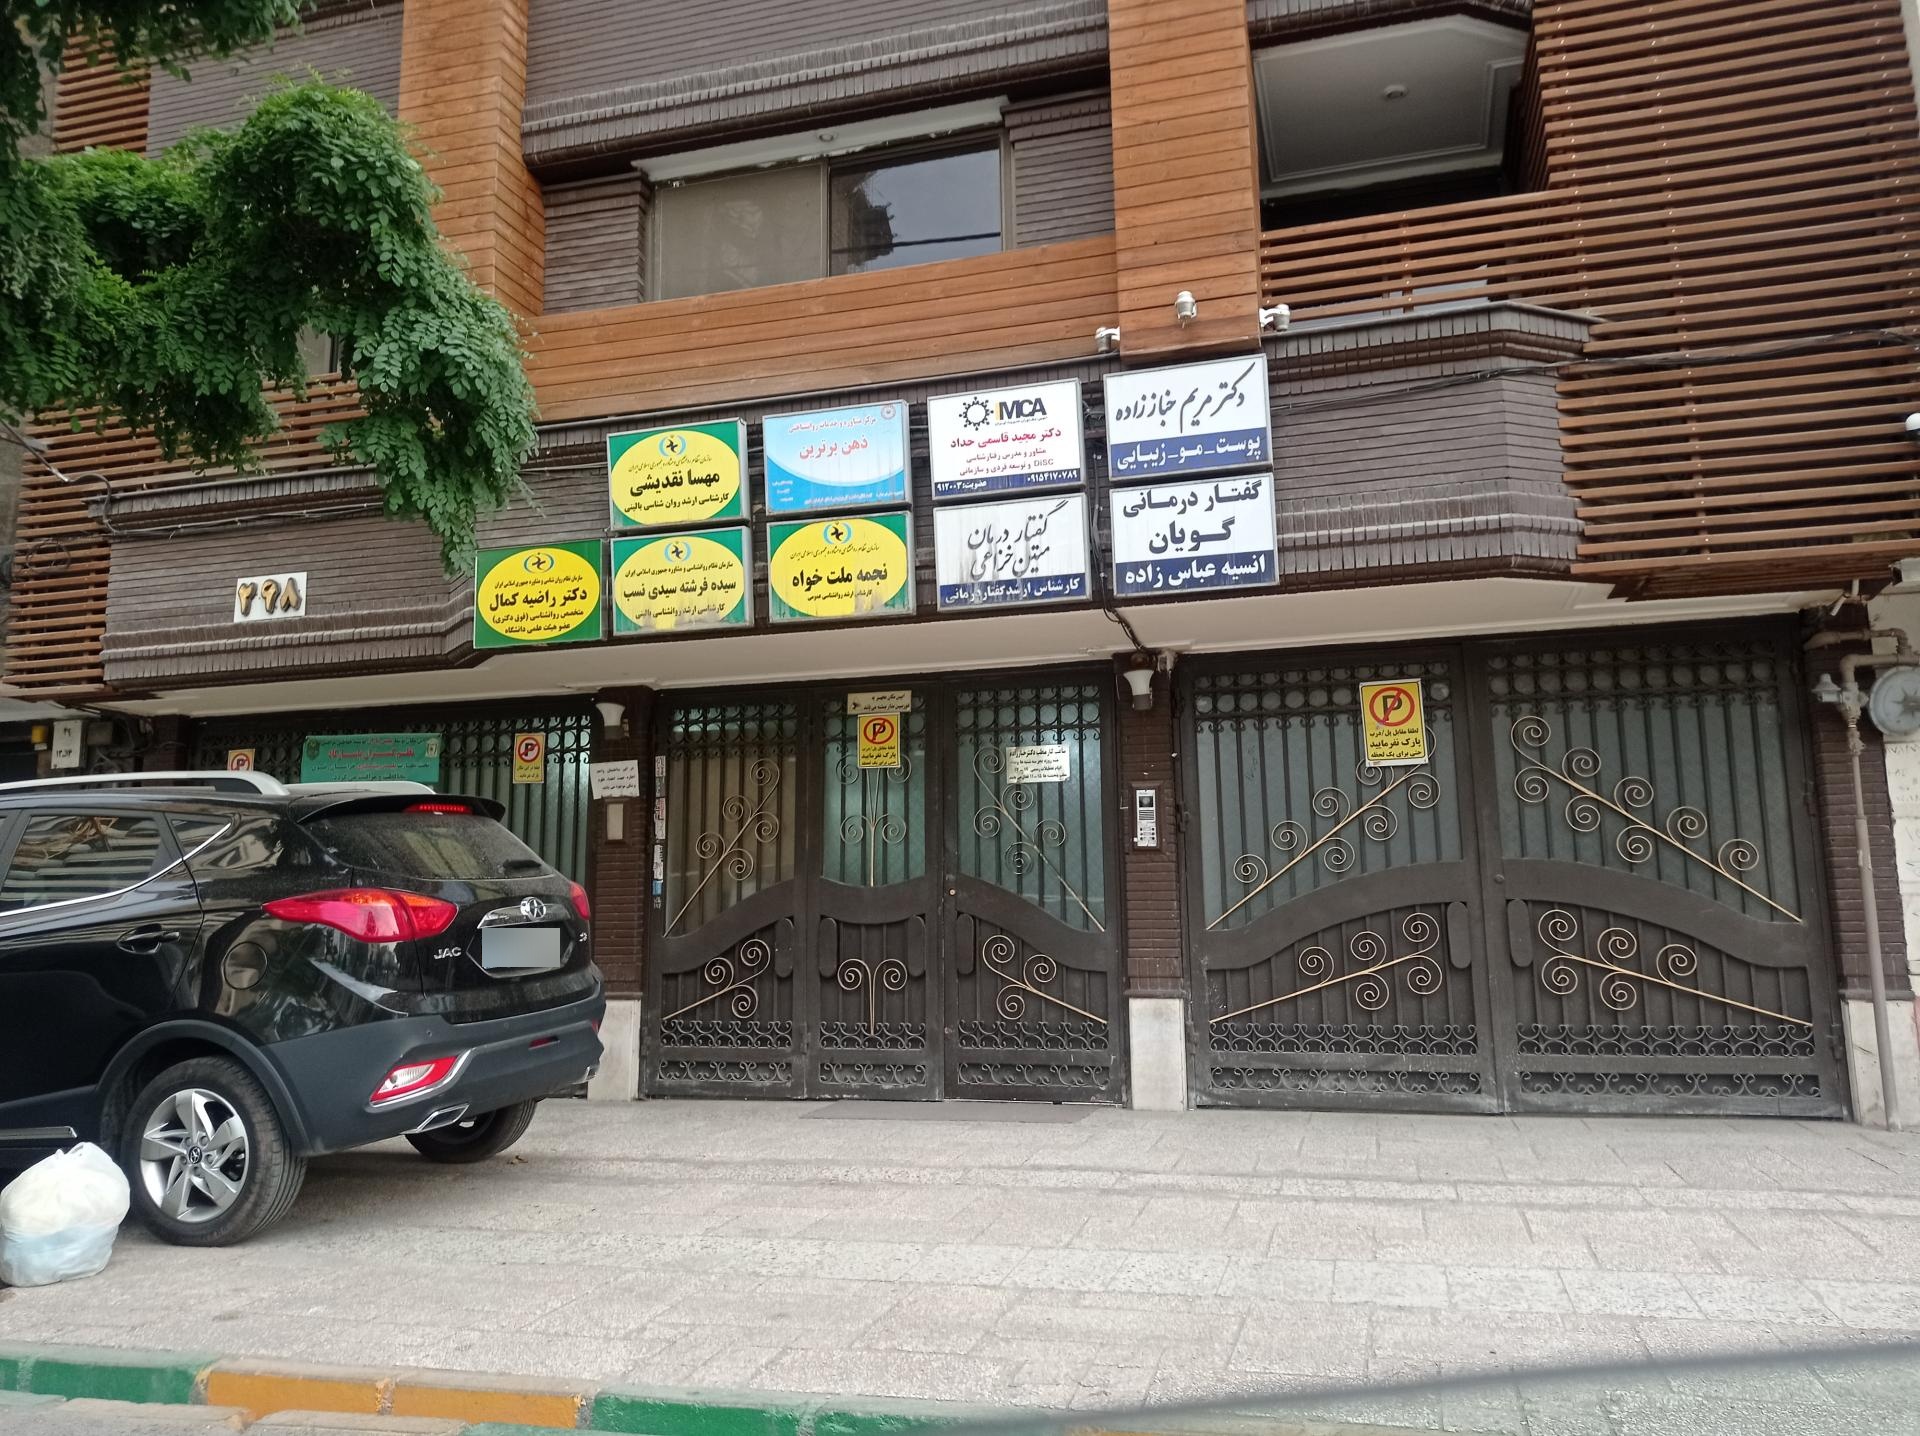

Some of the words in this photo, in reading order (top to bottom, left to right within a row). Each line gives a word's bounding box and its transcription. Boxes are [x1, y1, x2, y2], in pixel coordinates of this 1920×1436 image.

[1210, 362, 1256, 416] دکتر
[1180, 387, 1213, 434] مریم
[978, 432, 1009, 448] قاسمی
[1012, 432, 1036, 444] مجید
[1040, 427, 1061, 441] دکتر
[799, 439, 838, 460] برترین
[842, 434, 868, 456] ذهن
[950, 437, 975, 448] حداد
[1002, 452, 1021, 460] مدرس
[1029, 448, 1046, 457] مشاور
[959, 467, 984, 477] سازمانی
[991, 464, 1007, 473] فردی
[687, 468, 720, 488] مهسا
[665, 497, 680, 508] روان
[682, 495, 698, 506] ارشد
[699, 493, 730, 505] کارشناسی
[1123, 489, 1199, 518] درمانی
[1204, 479, 1262, 512] گفتار
[624, 502, 642, 513] بالینی
[643, 500, 664, 511] شناسی
[1014, 499, 1069, 543] گفتار
[967, 524, 1009, 550] درمان
[1148, 516, 1236, 554] گویان
[970, 544, 1014, 580] خزاعی
[1221, 554, 1266, 581] انسیه
[792, 569, 823, 592] خواه
[826, 566, 853, 585] ملت
[856, 563, 888, 586] نجمه
[1125, 563, 1164, 588] زاده
[1168, 560, 1216, 586] عباس
[623, 584, 645, 601] نسب
[648, 584, 677, 600] سیدی
[680, 577, 708, 597] فرشته
[711, 580, 737, 594] سیده
[945, 587, 982, 603] درمانی
[1006, 582, 1031, 597] ارشد
[1034, 578, 1080, 597] کارشناس
[238, 577, 302, 616] ۲۹۸
[489, 592, 519, 611] کمال
[522, 589, 556, 608] راضیه
[560, 587, 587, 606] دکتر
[530, 610, 559, 621] روانشناسی
[560, 608, 584, 619] متخصص
[698, 603, 725, 615] کارشناسی
[505, 626, 526, 634] دانشگاه
[527, 625, 542, 634] علمی
[558, 623, 570, 632] عضو
[1401, 738, 1421, 747] پارک
[433, 946, 462, 960] JAC
